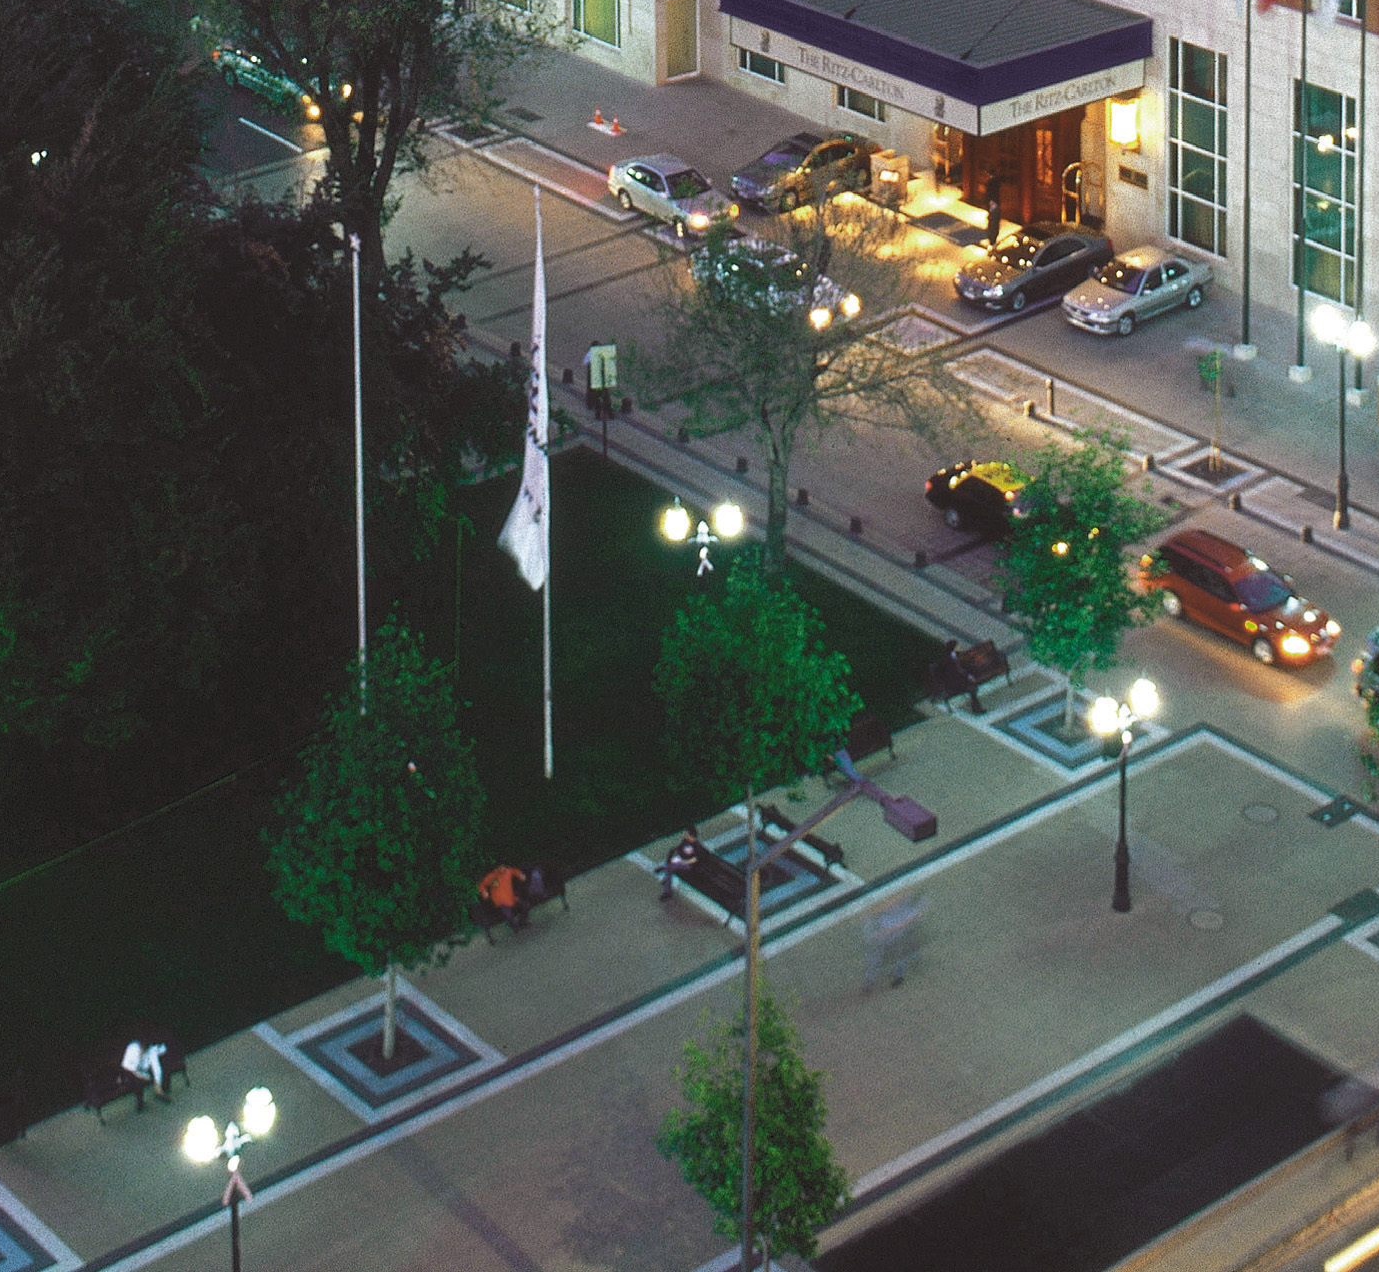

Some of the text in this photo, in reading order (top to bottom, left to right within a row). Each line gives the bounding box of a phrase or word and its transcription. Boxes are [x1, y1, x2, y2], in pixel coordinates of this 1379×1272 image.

[798, 46, 905, 100] THE RITZ-CARLTON
[1009, 75, 1117, 118] THE RITZ-CARLTON
